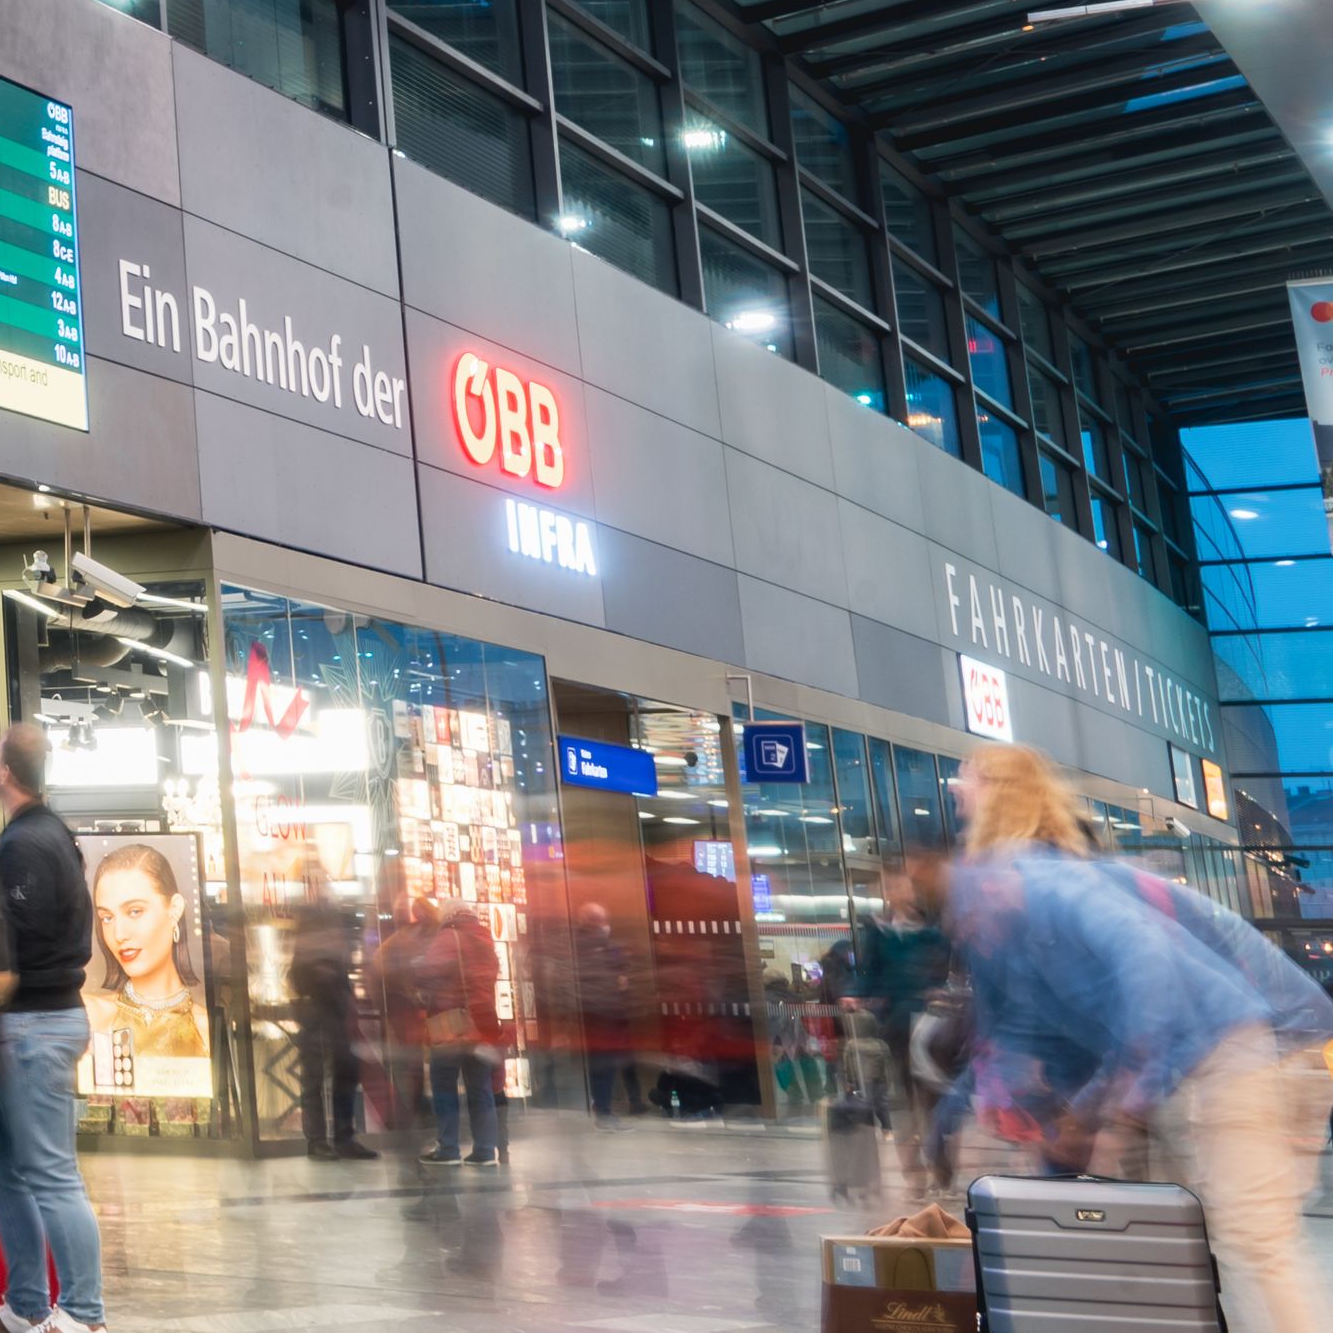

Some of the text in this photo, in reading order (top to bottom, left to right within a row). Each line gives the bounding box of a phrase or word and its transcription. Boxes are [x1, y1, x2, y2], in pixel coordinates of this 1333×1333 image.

[48, 185, 70, 210] BUS
[29, 368, 48, 387] and
[118, 258, 405, 429] Ein Bahnhof der
[452, 351, 566, 488] ÖBB
[505, 498, 596, 576] INFRA
[945, 562, 1215, 754] FAHRKARTEN TICKETS
[886, 1303, 933, 1321] Lindt
